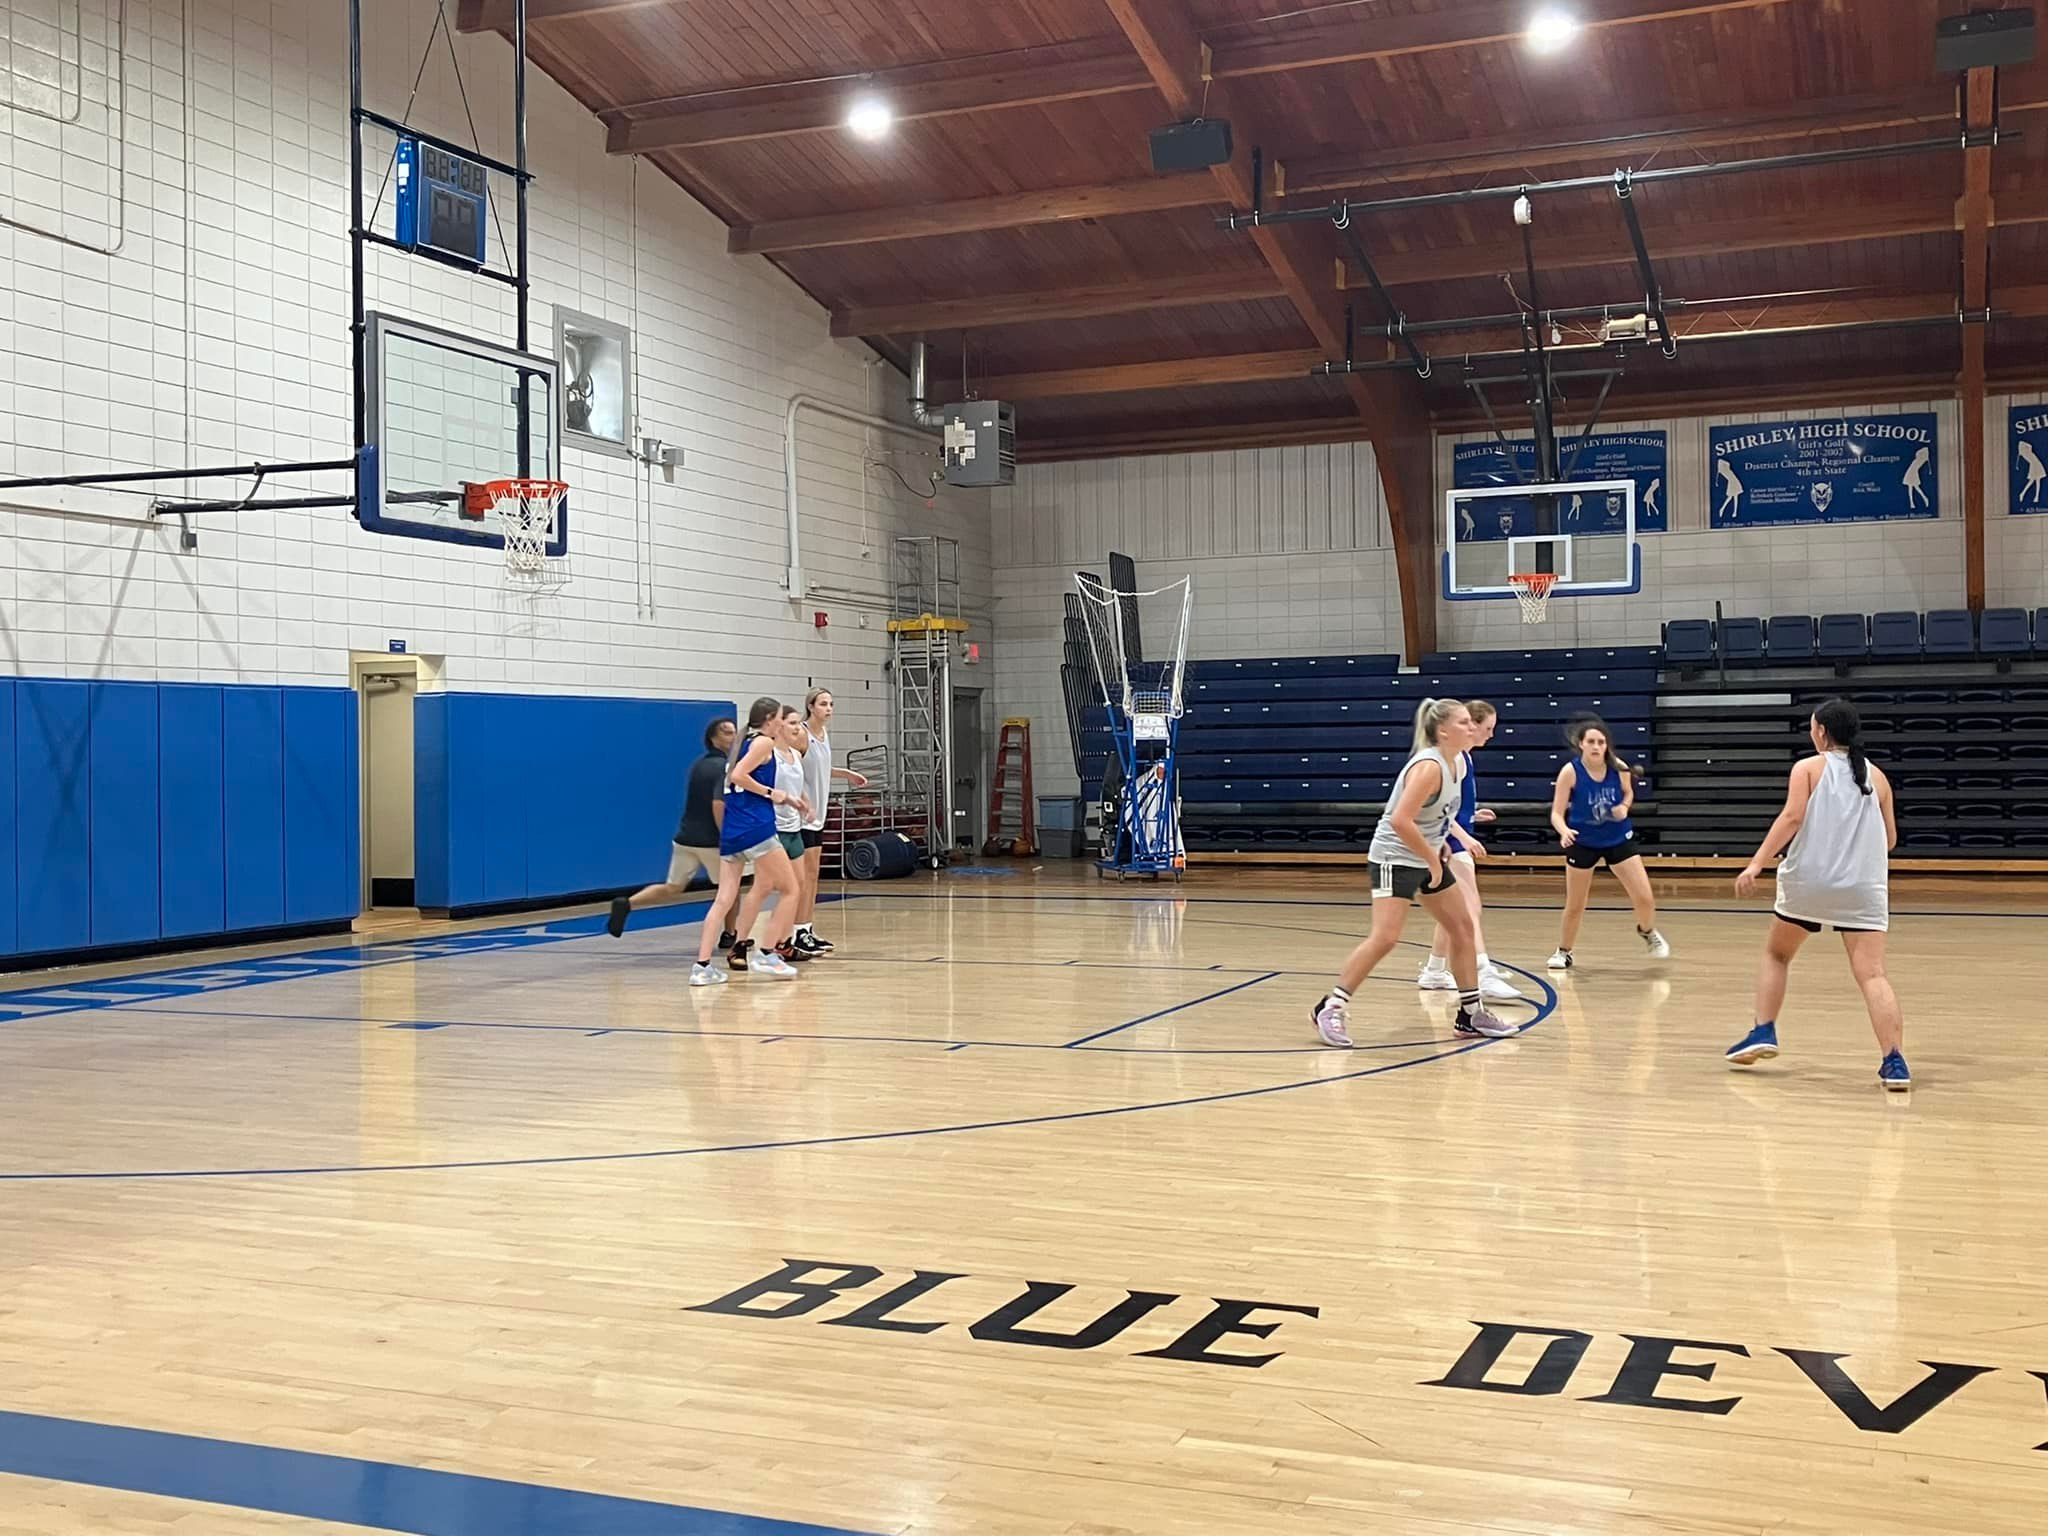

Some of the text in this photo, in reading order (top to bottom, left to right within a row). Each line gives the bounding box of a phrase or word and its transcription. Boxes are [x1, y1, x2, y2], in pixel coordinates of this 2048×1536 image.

[1561, 437, 1665, 454] SHILEY HIGH SCHOOL
[1715, 423, 1932, 456] SHIRLEY HIGH SCHOOL
[1798, 439, 1845, 450] Girl's Golf
[1455, 447, 1494, 461] SHIRLEY
[1799, 448, 1844, 458] 2001-2002
[1744, 454, 1900, 471] District Champs, Regional Champs
[1797, 466, 1847, 477] 4th at State
[679, 1256, 2048, 1452] BLUE DEV
